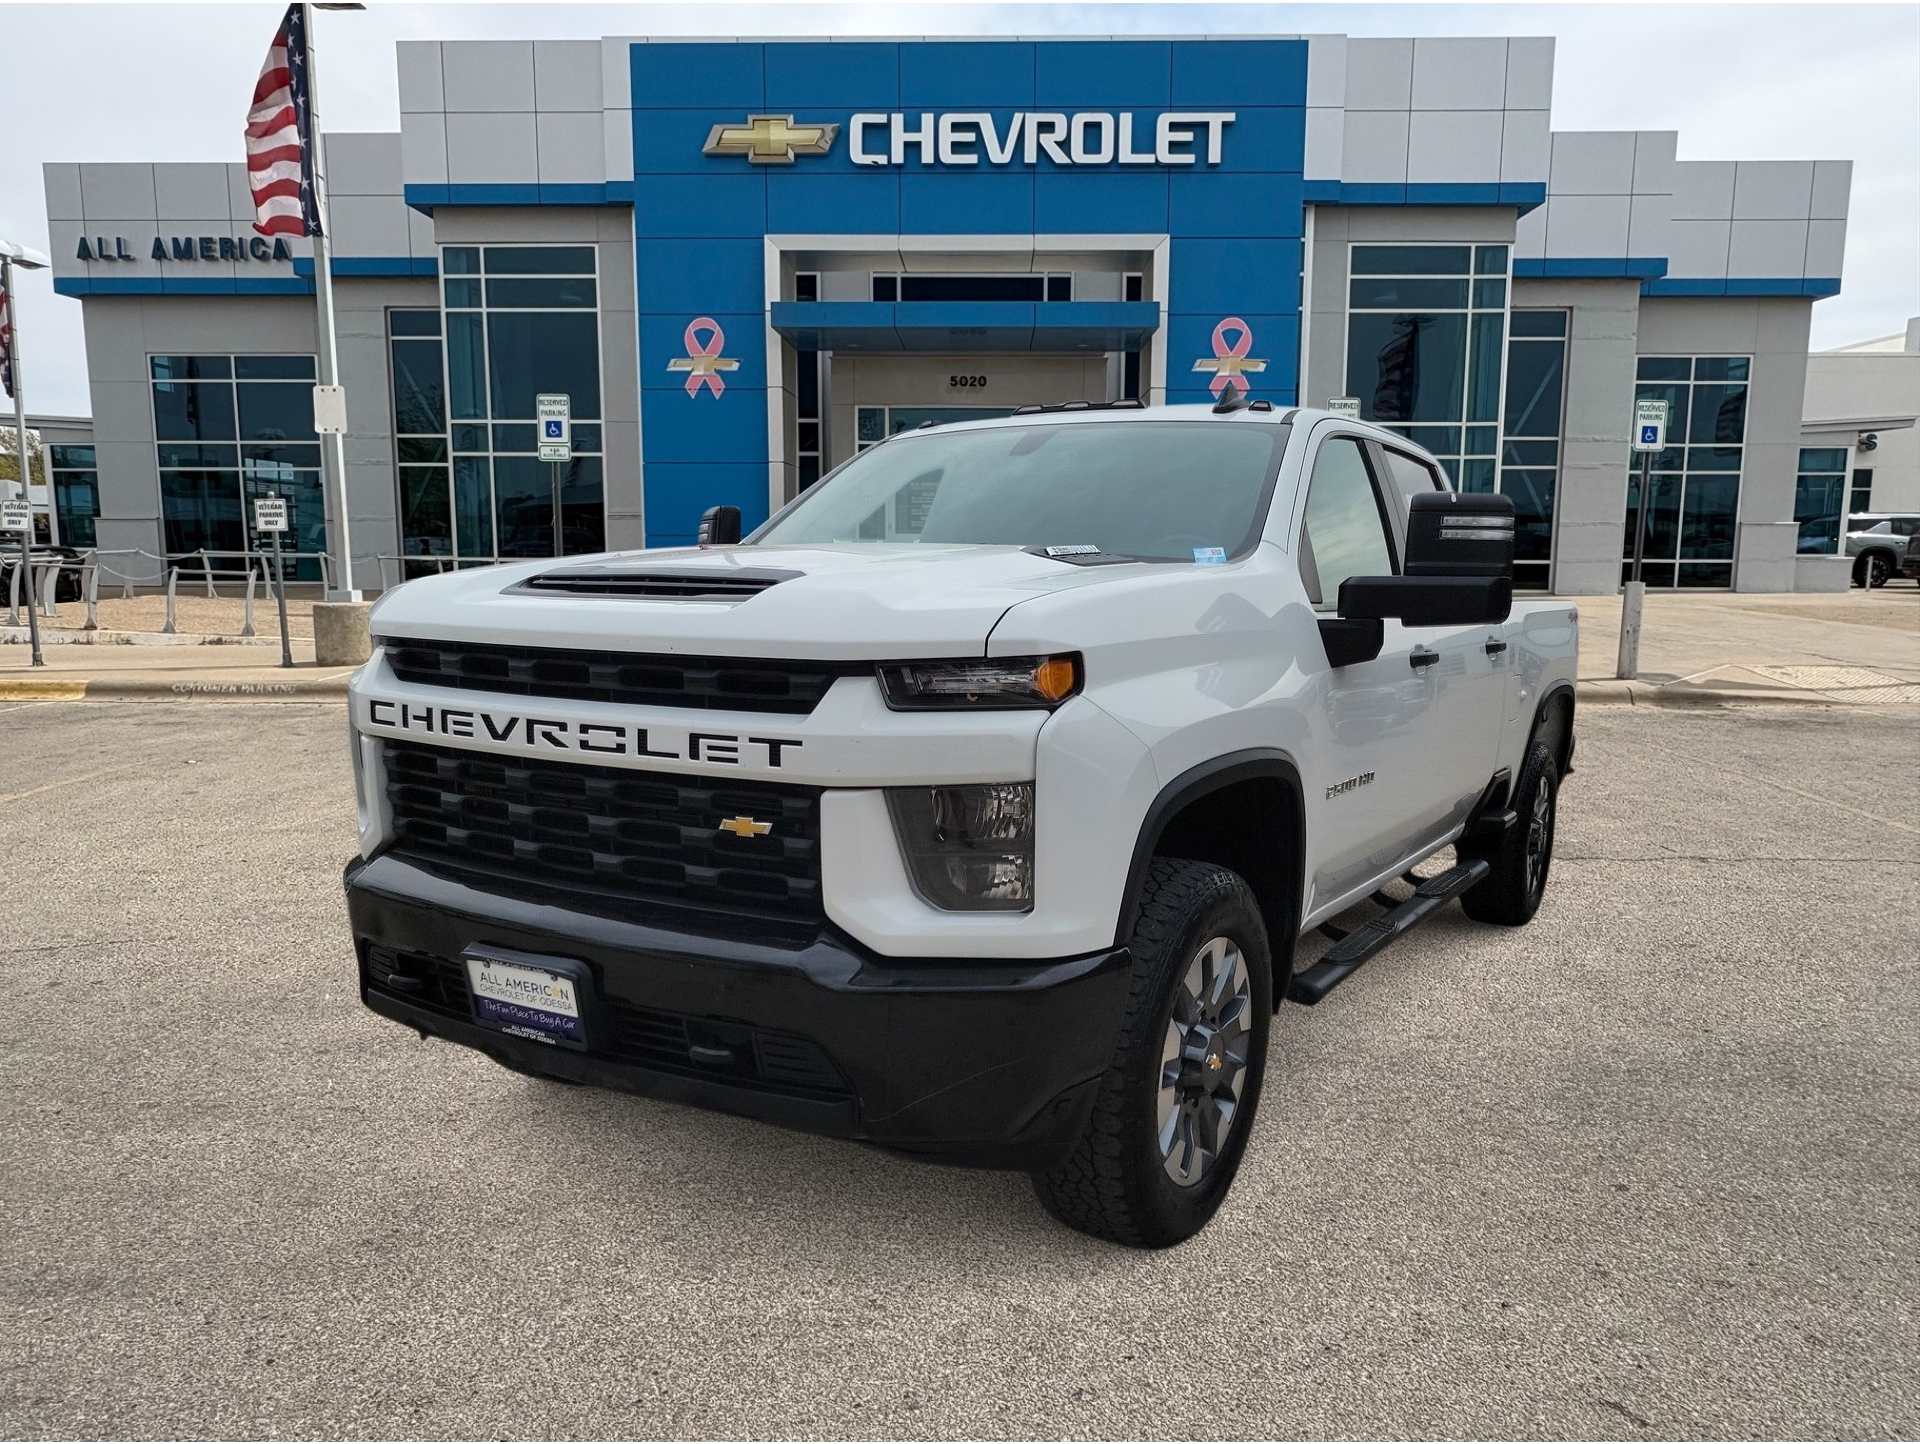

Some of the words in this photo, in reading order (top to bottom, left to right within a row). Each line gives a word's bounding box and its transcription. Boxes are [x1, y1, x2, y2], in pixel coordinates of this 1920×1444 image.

[849, 112, 1237, 166] CHEVROLET
[76, 236, 136, 261] ALL
[949, 375, 987, 387] 5020
[540, 408, 567, 417] PARKING
[370, 699, 803, 768] CHEVROLET
[480, 971, 502, 986] ALL
[480, 983, 525, 1000] CHEVROLET
[526, 994, 538, 1003] OF
[539, 996, 573, 1010] ODESSA
